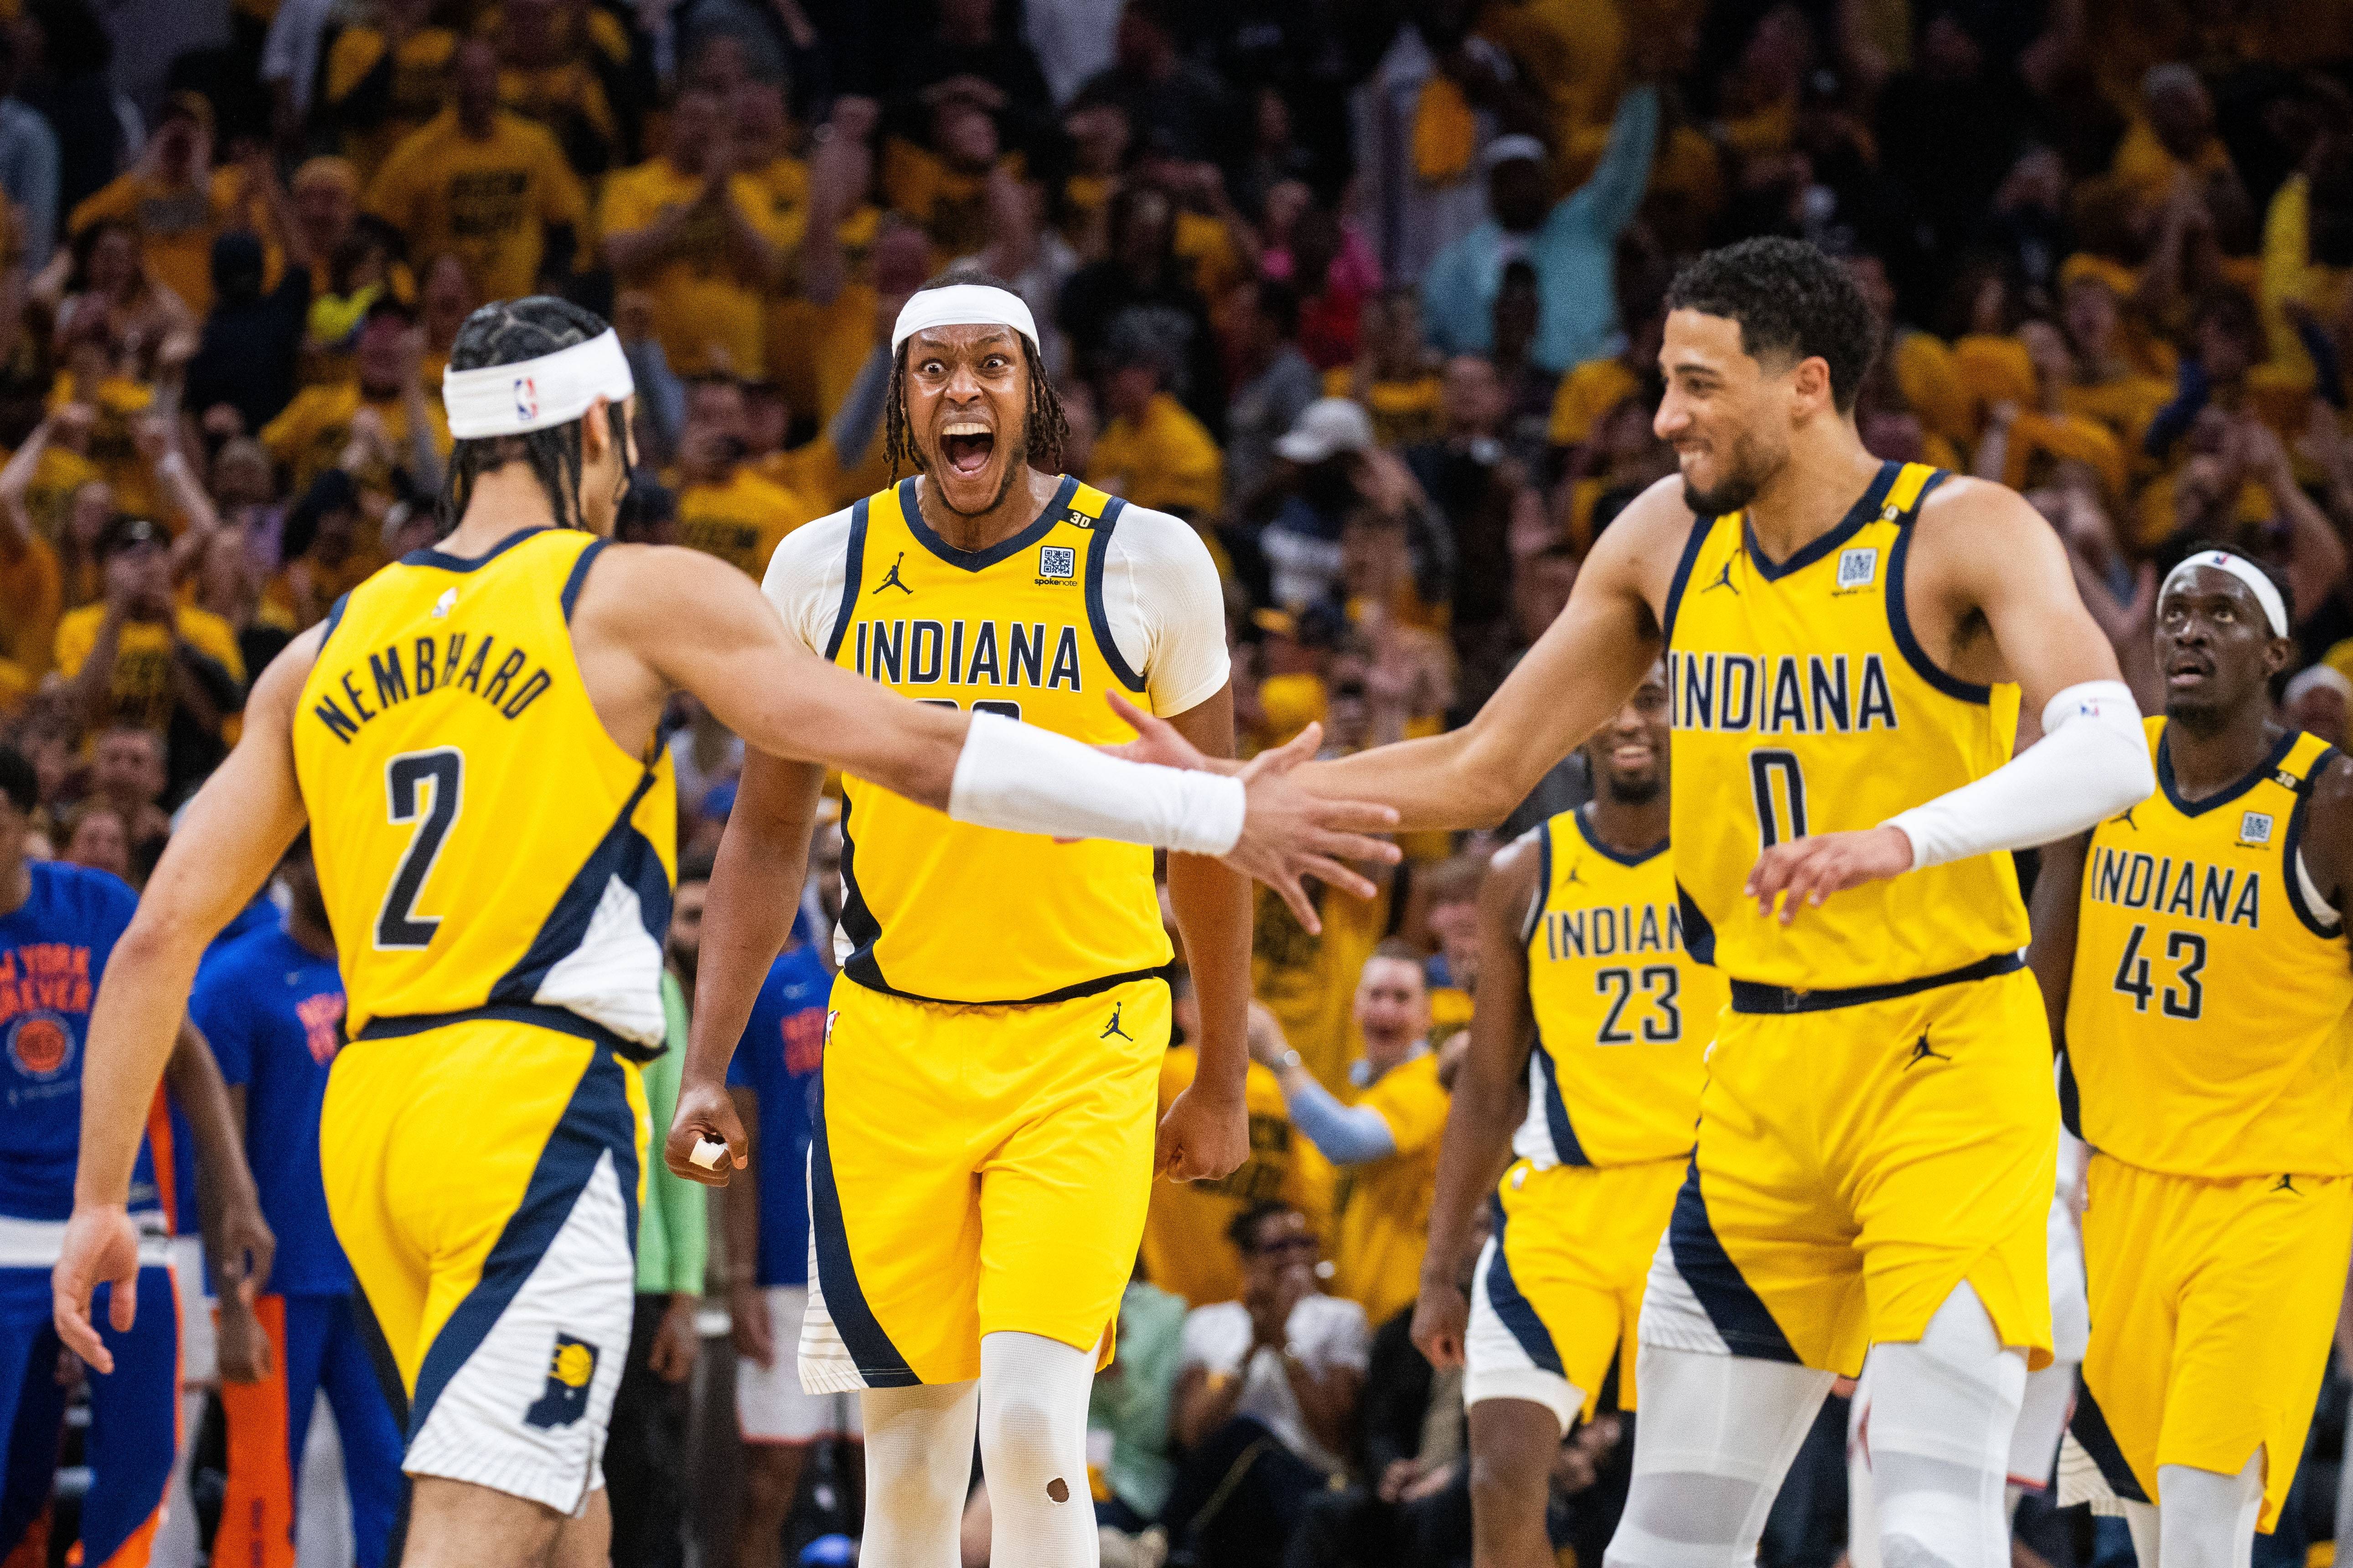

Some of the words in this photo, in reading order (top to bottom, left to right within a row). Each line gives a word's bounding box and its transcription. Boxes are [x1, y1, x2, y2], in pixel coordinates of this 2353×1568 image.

[1070, 511, 1091, 527] 30
[1034, 578, 1078, 587] spokenote
[313, 632, 552, 744] NEMBHARD
[855, 619, 1082, 693] INDIANA
[1668, 650, 1899, 735] INDIANA
[1747, 746, 1808, 857] 0
[372, 745, 465, 952] 2
[2090, 845, 2260, 930] INDIANA
[1545, 903, 1684, 962] INDIAN
[2112, 922, 2208, 1021] 43
[1594, 963, 1682, 1047] 23
